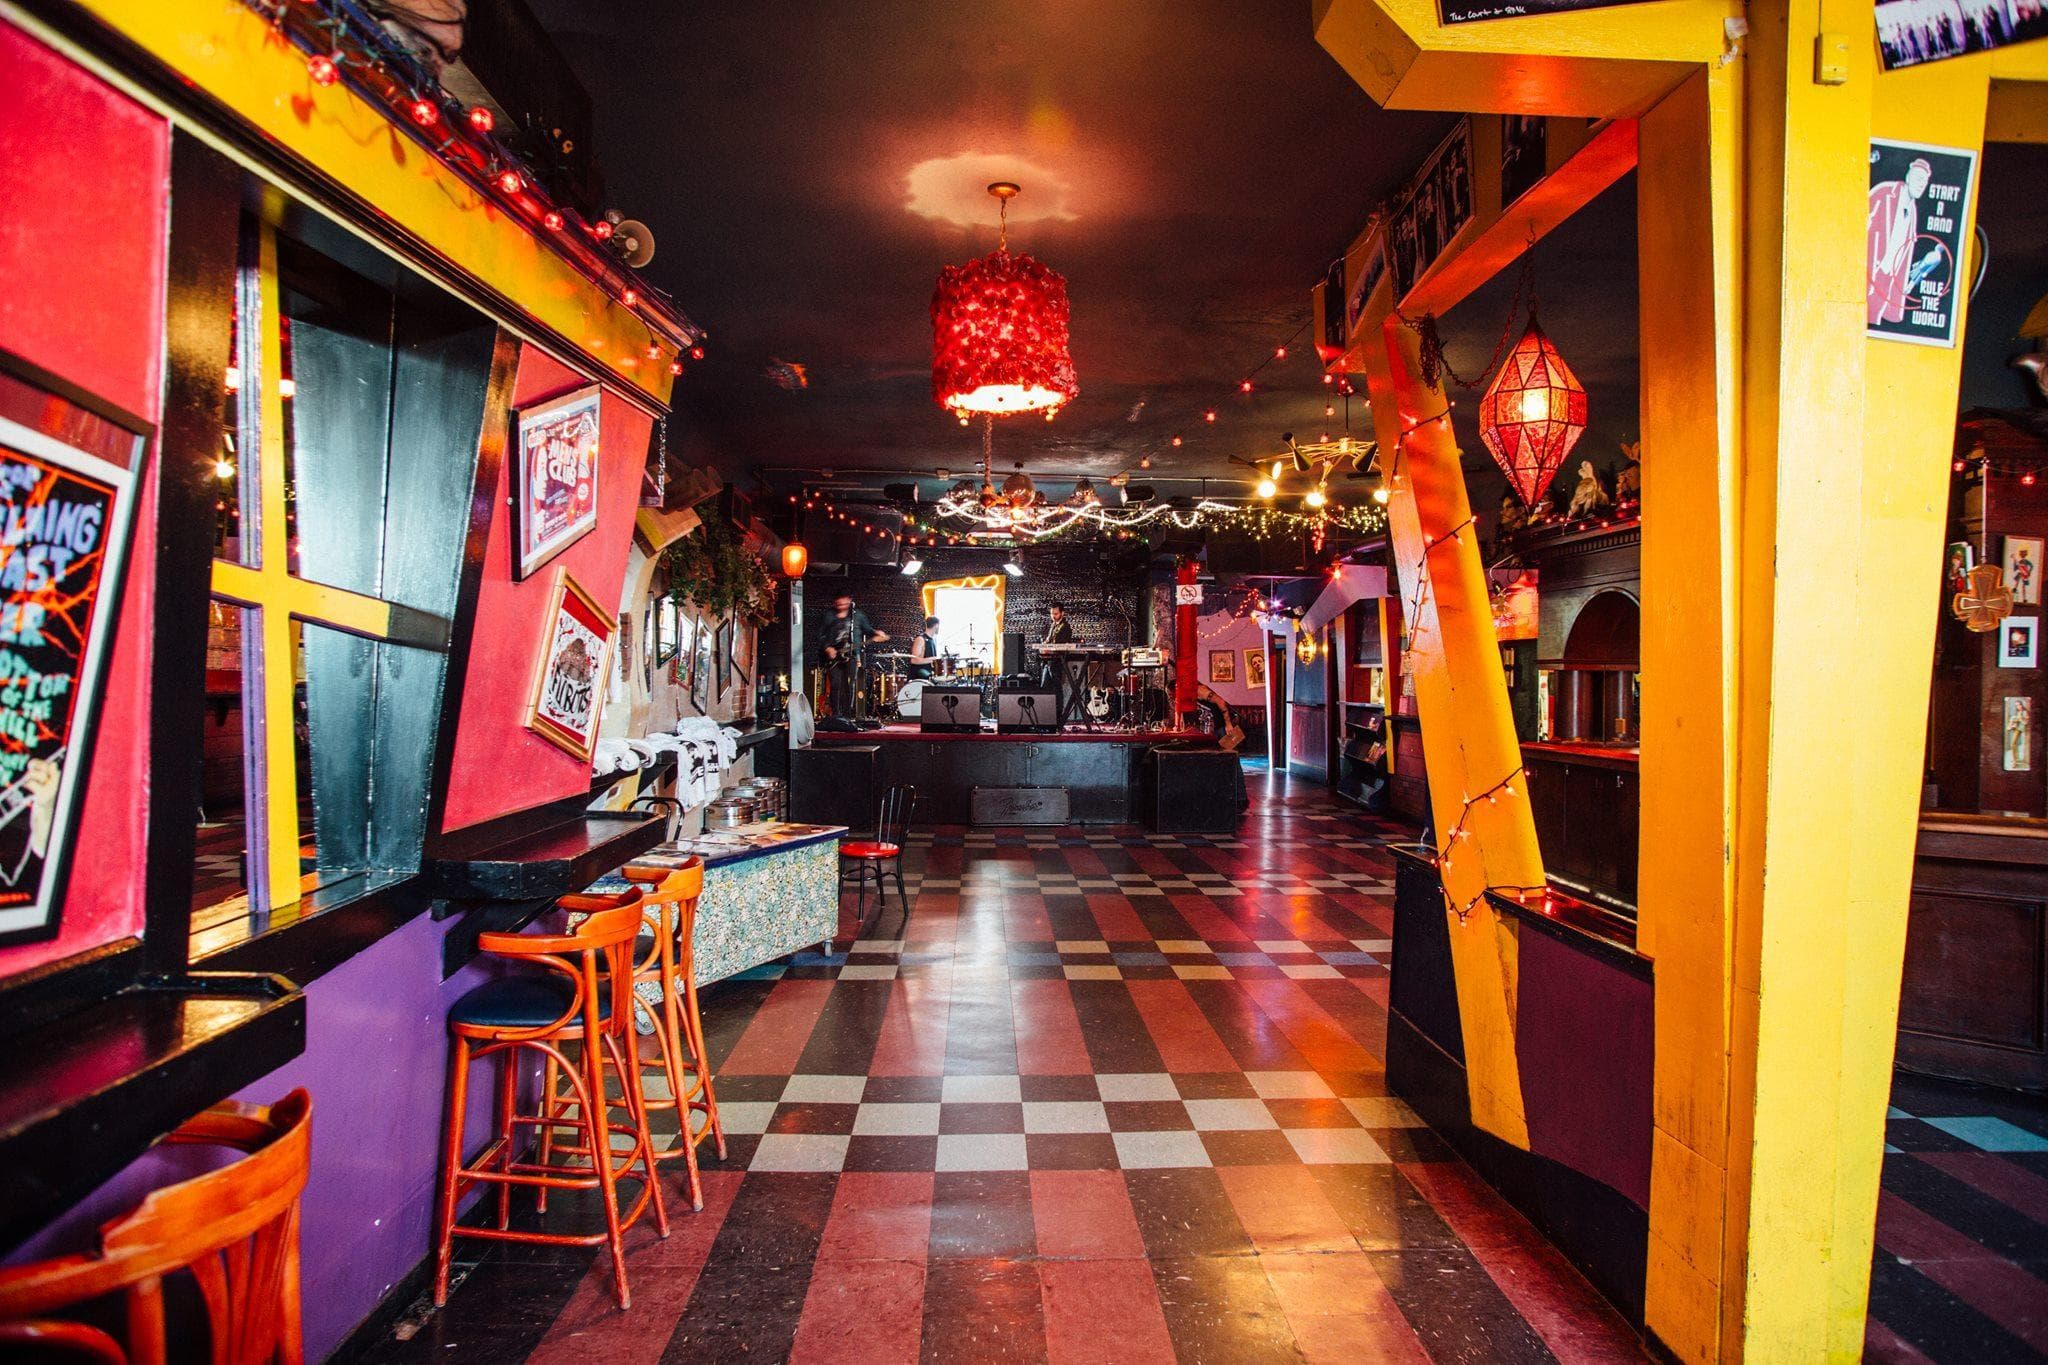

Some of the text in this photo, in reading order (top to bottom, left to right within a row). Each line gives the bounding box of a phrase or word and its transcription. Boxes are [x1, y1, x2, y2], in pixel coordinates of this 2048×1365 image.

[1449, 12, 1466, 21] The
[1929, 184, 1960, 201] START
[1936, 201, 1944, 216] A
[1927, 216, 1953, 233] BAND
[1920, 280, 1944, 295] RULE
[1921, 295, 1940, 311] THE
[1912, 311, 1946, 328] WORLD
[0, 543, 75, 591] AST
[0, 601, 46, 647] ER
